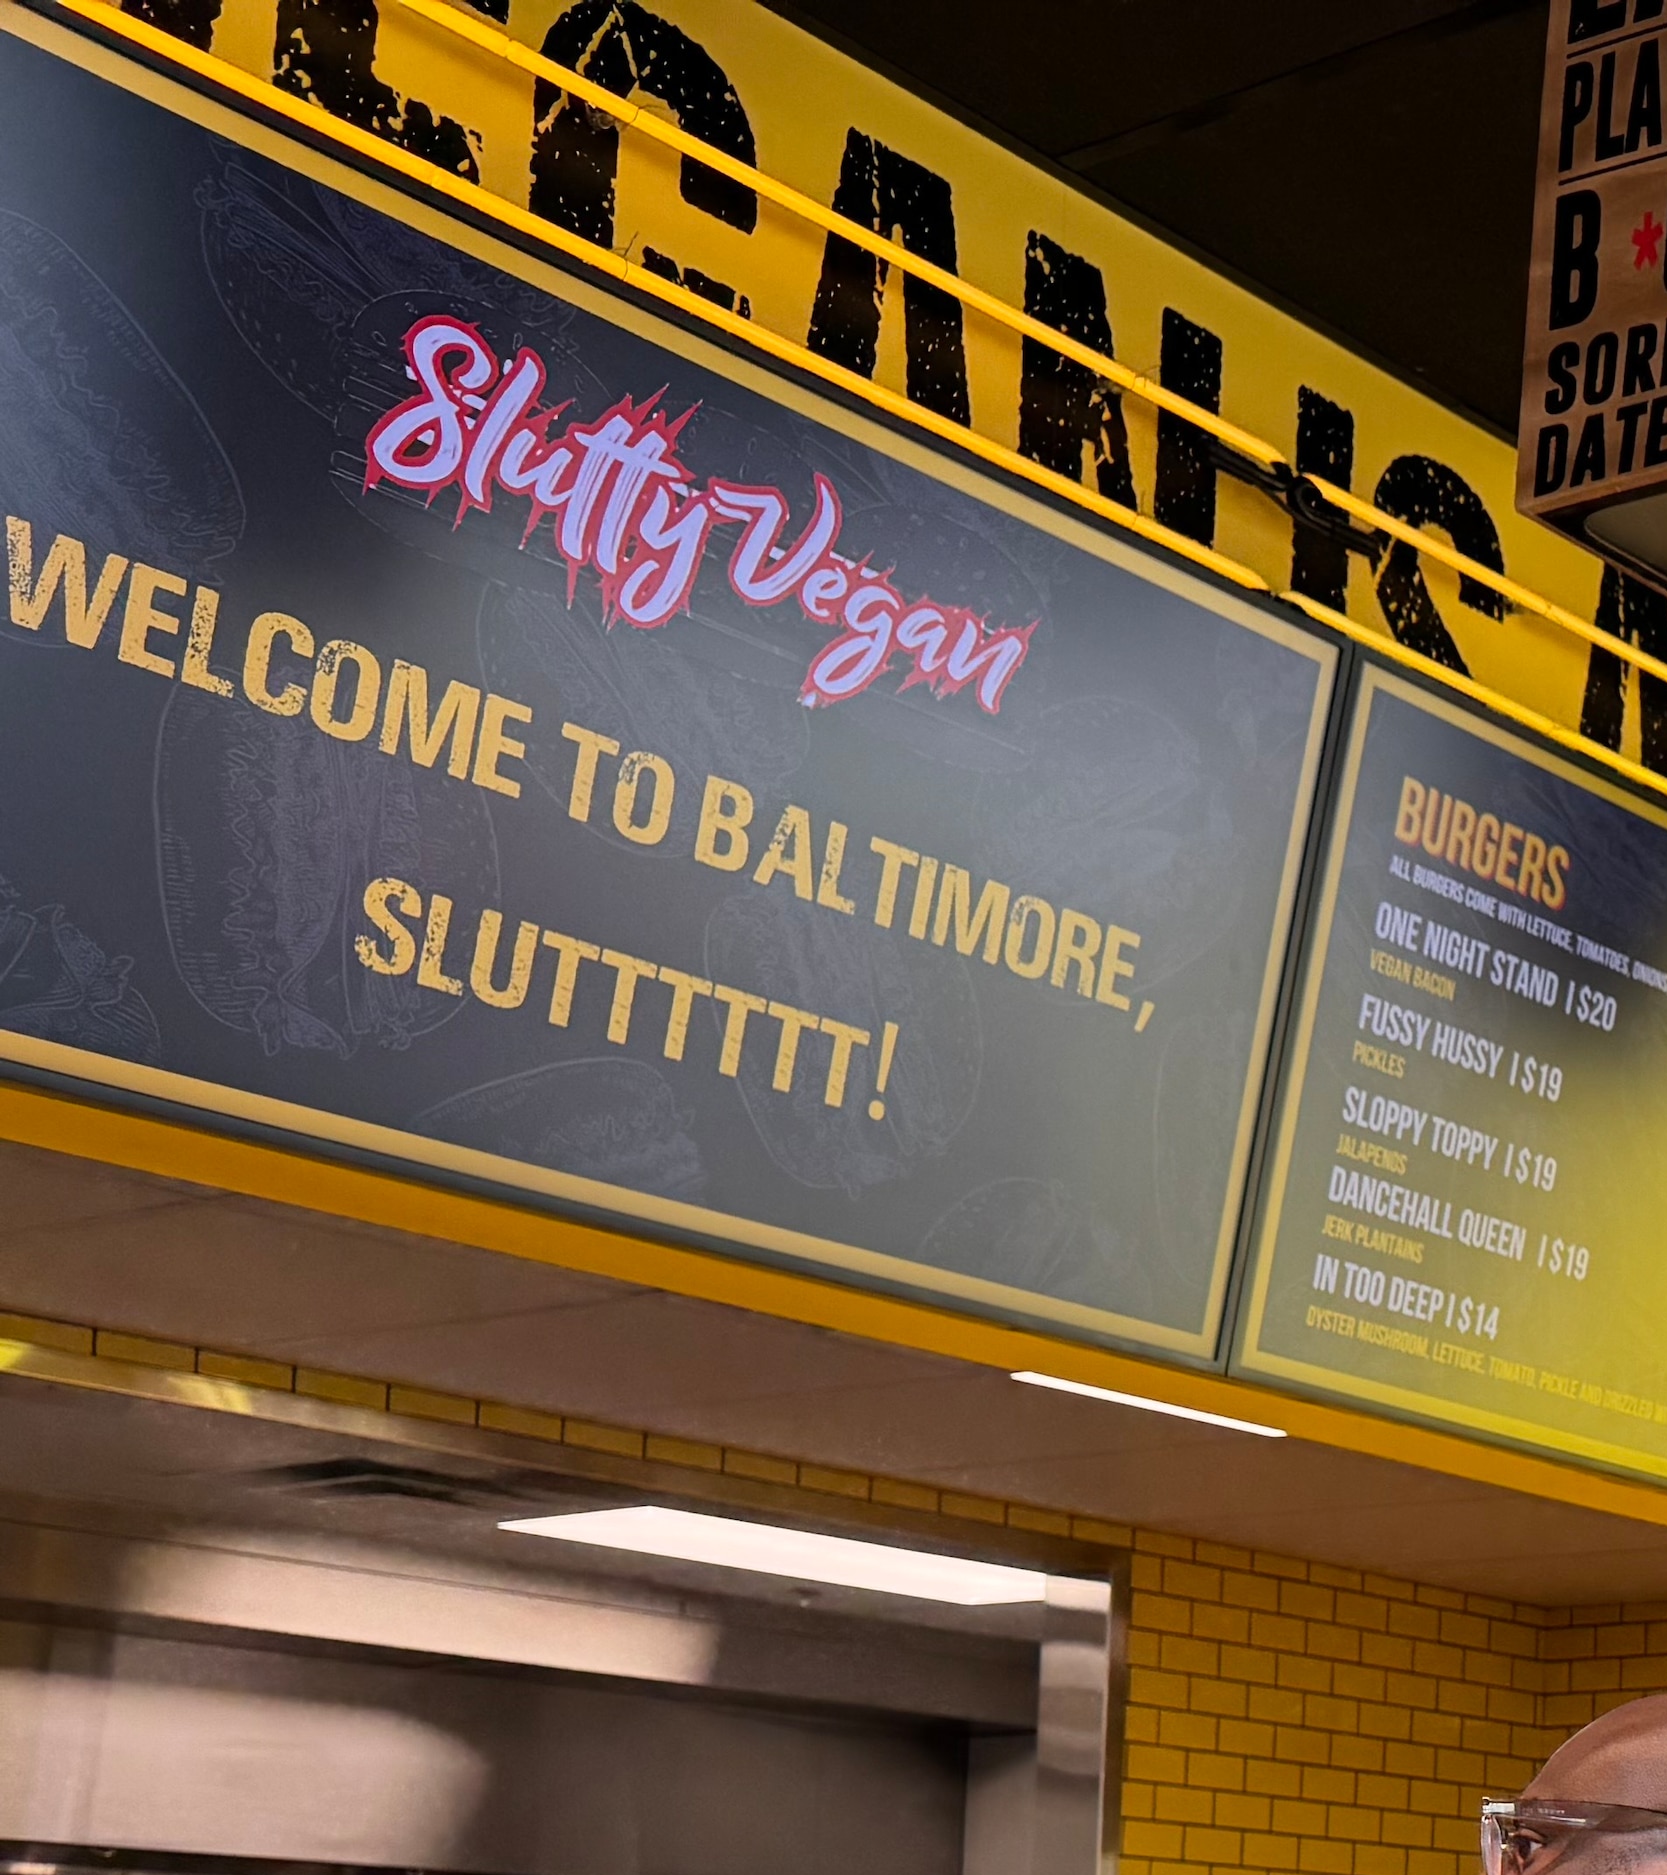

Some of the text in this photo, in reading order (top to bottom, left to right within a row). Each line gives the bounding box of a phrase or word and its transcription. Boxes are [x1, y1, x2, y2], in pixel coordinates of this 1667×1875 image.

[115, 0, 1505, 682] EGANS
[364, 314, 1040, 718] Slutty Vegan
[4, 512, 1157, 1033] WELCOME TO BALTIMORE,
[1395, 775, 1572, 912] BURGERS
[1389, 854, 1412, 880] ALL
[1413, 862, 1466, 905] BURGERS
[1465, 882, 1499, 920] COME
[1498, 895, 1528, 931] WITH
[354, 875, 903, 1121] SLUTTTTTT!
[1370, 948, 1457, 1002] VEGAN BACON
[1375, 901, 1420, 952] ONE
[1423, 919, 1491, 980] NIGHT
[1490, 949, 1560, 1009] STAND
[1352, 1039, 1407, 1080] PICKLES
[1358, 992, 1432, 1052] FUSSY
[1431, 1021, 1504, 1080] HUSSY
[1335, 1132, 1409, 1177] JALAPENOS
[1342, 1085, 1429, 1148] SLOPPY
[1429, 1115, 1499, 1172] TOPPY
[1321, 1213, 1426, 1265] JERK PLANTAINS
[1327, 1164, 1453, 1240] DANCEHALL
[1458, 1207, 1528, 1263] QUEEN
[1305, 1304, 1356, 1338] OYSTER
[1312, 1253, 1340, 1296] IN
[1343, 1260, 1387, 1308] TOO
[1387, 1275, 1445, 1324] DEEP
